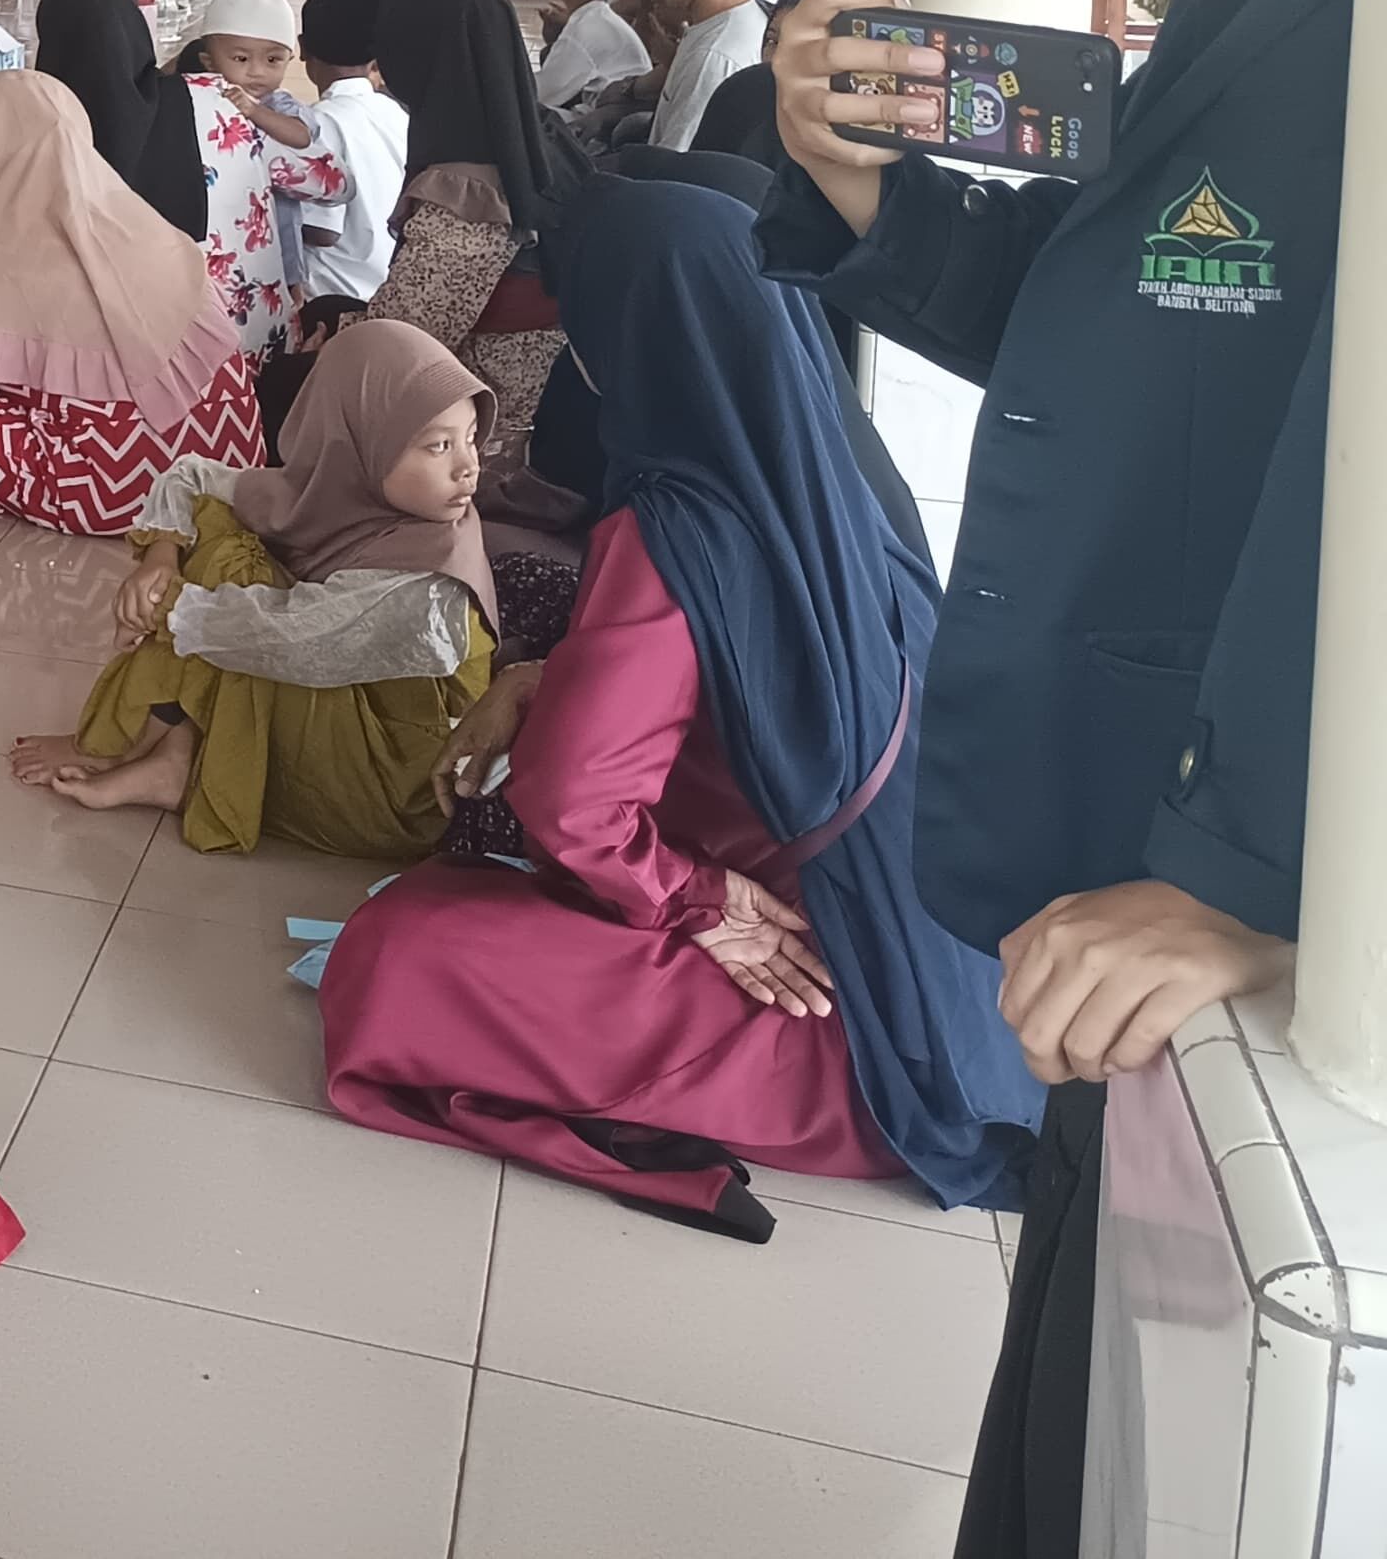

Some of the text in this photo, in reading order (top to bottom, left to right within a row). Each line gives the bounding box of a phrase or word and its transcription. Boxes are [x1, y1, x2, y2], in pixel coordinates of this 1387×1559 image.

[1022, 124, 1034, 155] NEW
[1049, 115, 1064, 158] LUCK
[1066, 117, 1082, 159] GOOD
[1157, 295, 1200, 310] BANGKA
